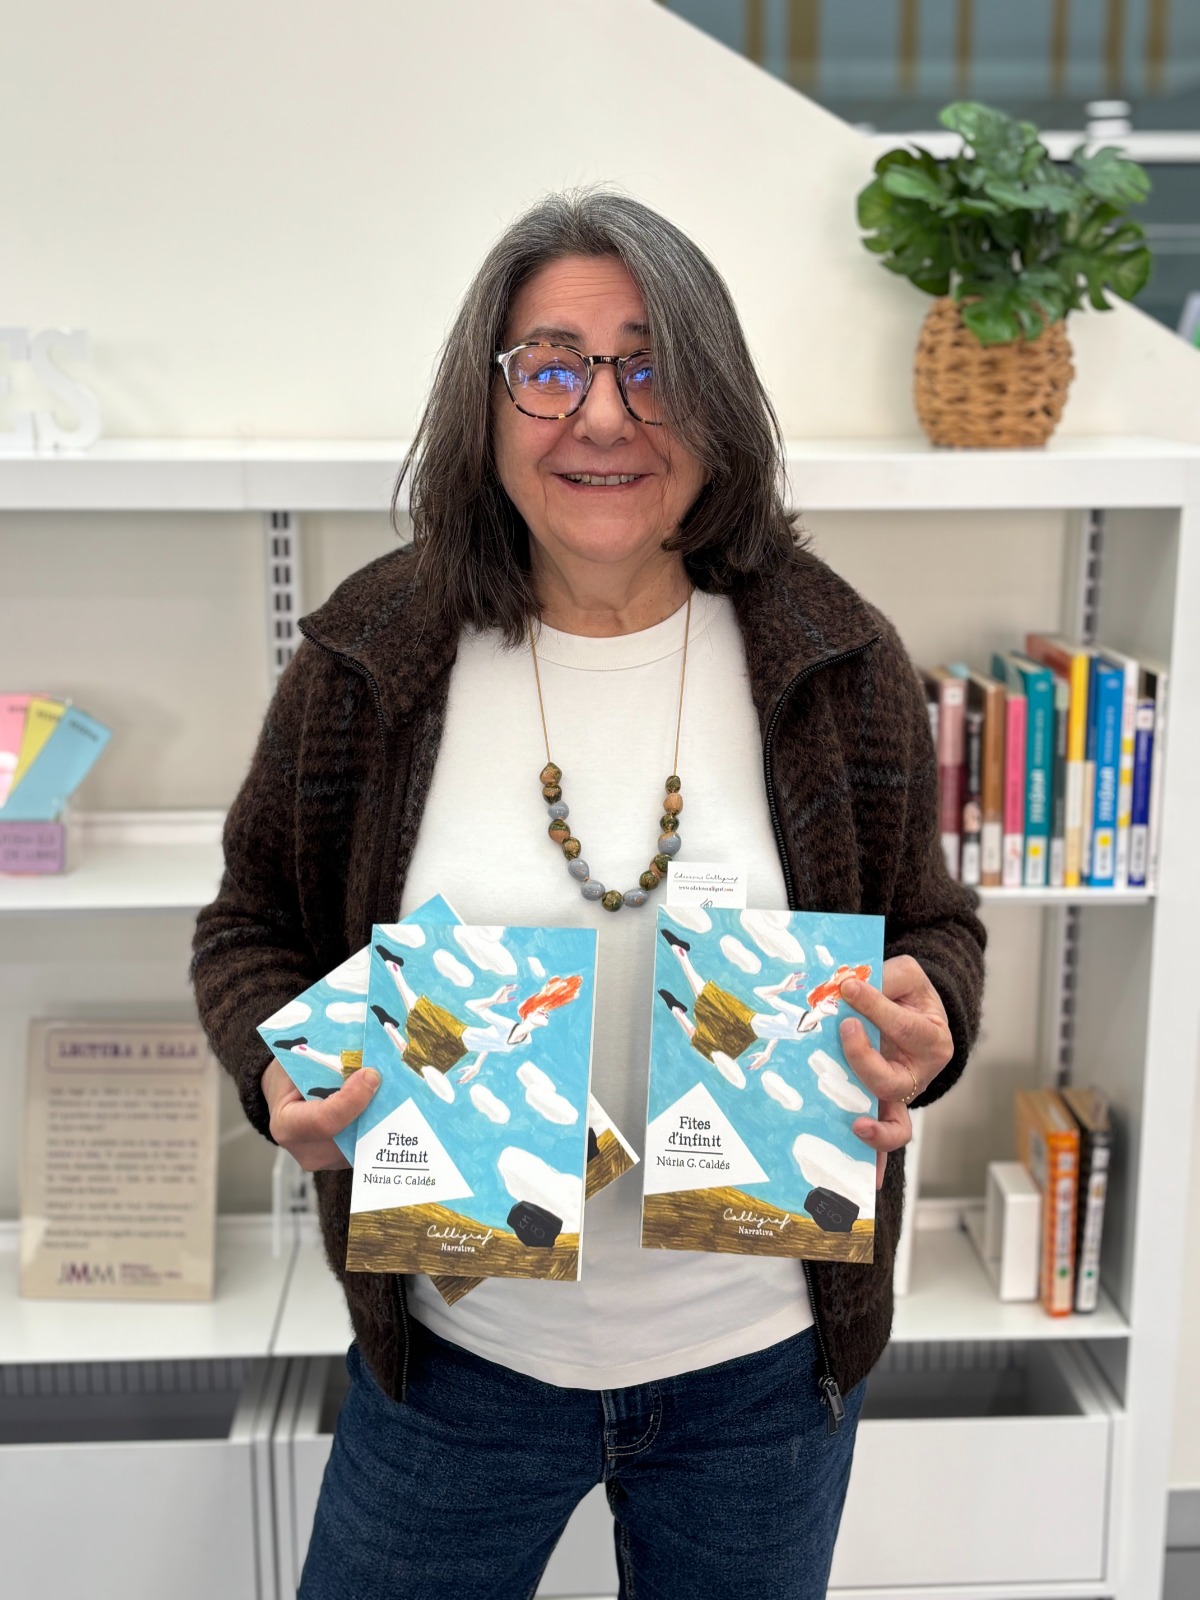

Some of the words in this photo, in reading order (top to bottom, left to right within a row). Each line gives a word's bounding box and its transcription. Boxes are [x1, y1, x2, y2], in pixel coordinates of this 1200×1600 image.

[679, 1116, 711, 1130] Fites
[387, 1132, 419, 1146] Fites
[668, 1132, 722, 1148] d'infinit
[375, 1149, 429, 1164] d'infinit
[656, 1156, 685, 1168] Núria
[687, 1158, 697, 1169] G.
[698, 1158, 731, 1170] Caldés
[363, 1173, 391, 1185] Núria
[393, 1175, 403, 1185] G.
[405, 1175, 436, 1186] Caldés
[722, 1207, 792, 1230] Calligraf
[426, 1224, 494, 1246] Calligraf
[738, 1225, 774, 1237] Narrativa
[441, 1242, 476, 1253] Narrativa
